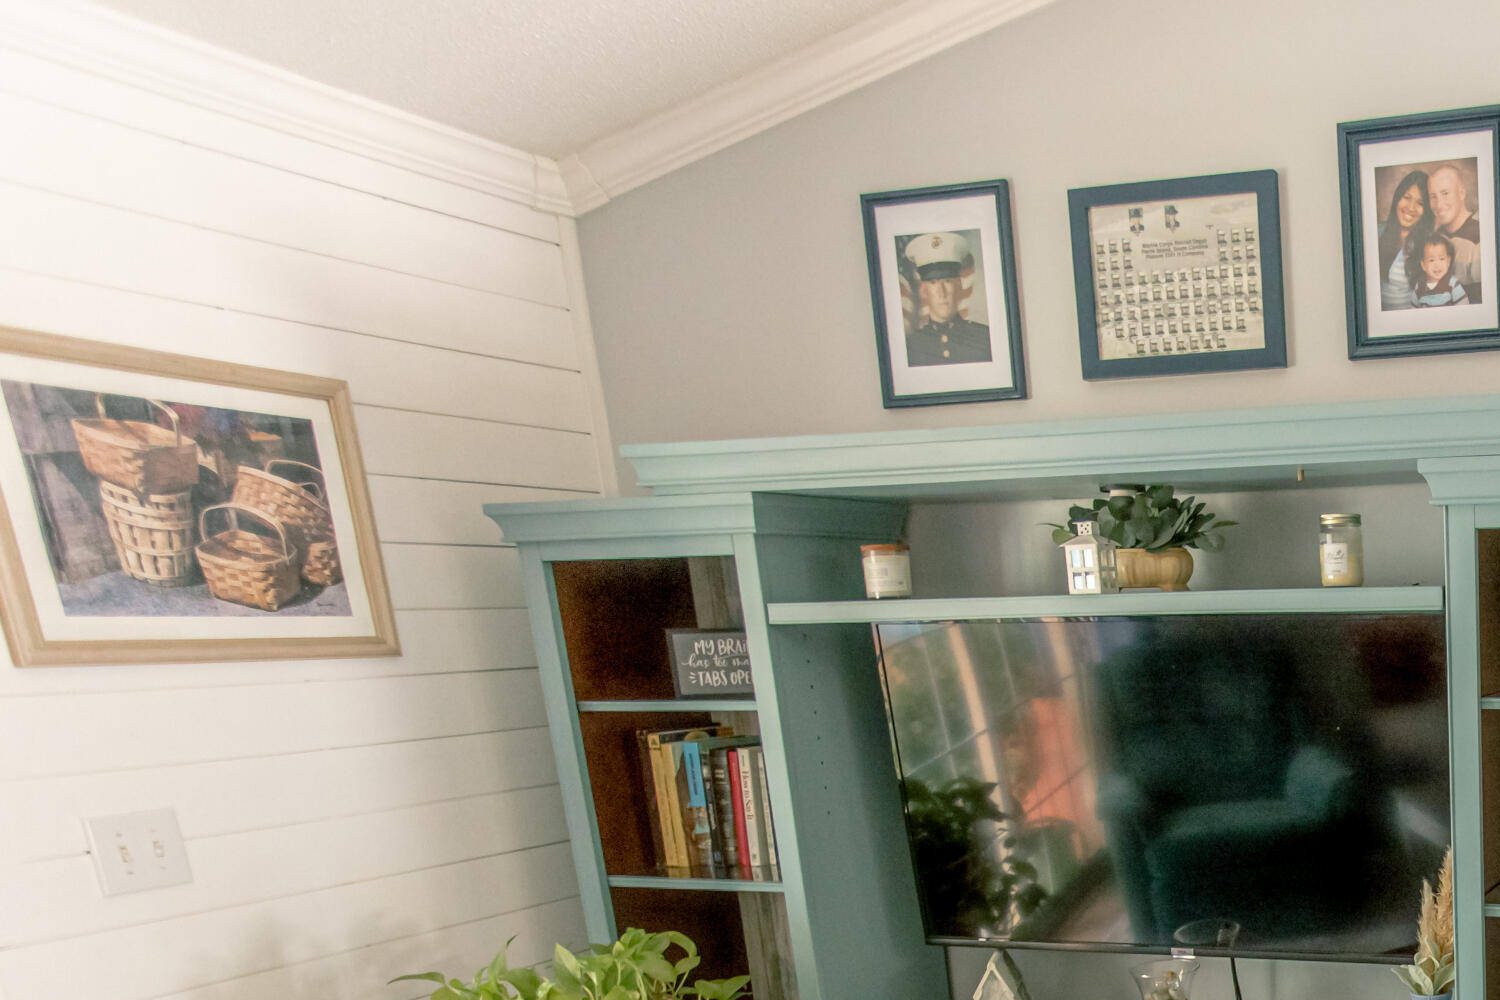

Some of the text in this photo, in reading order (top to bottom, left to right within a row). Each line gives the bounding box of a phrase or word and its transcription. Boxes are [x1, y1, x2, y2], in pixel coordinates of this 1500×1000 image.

[695, 639, 715, 656] MY
[698, 669, 752, 687] TABS OPE
